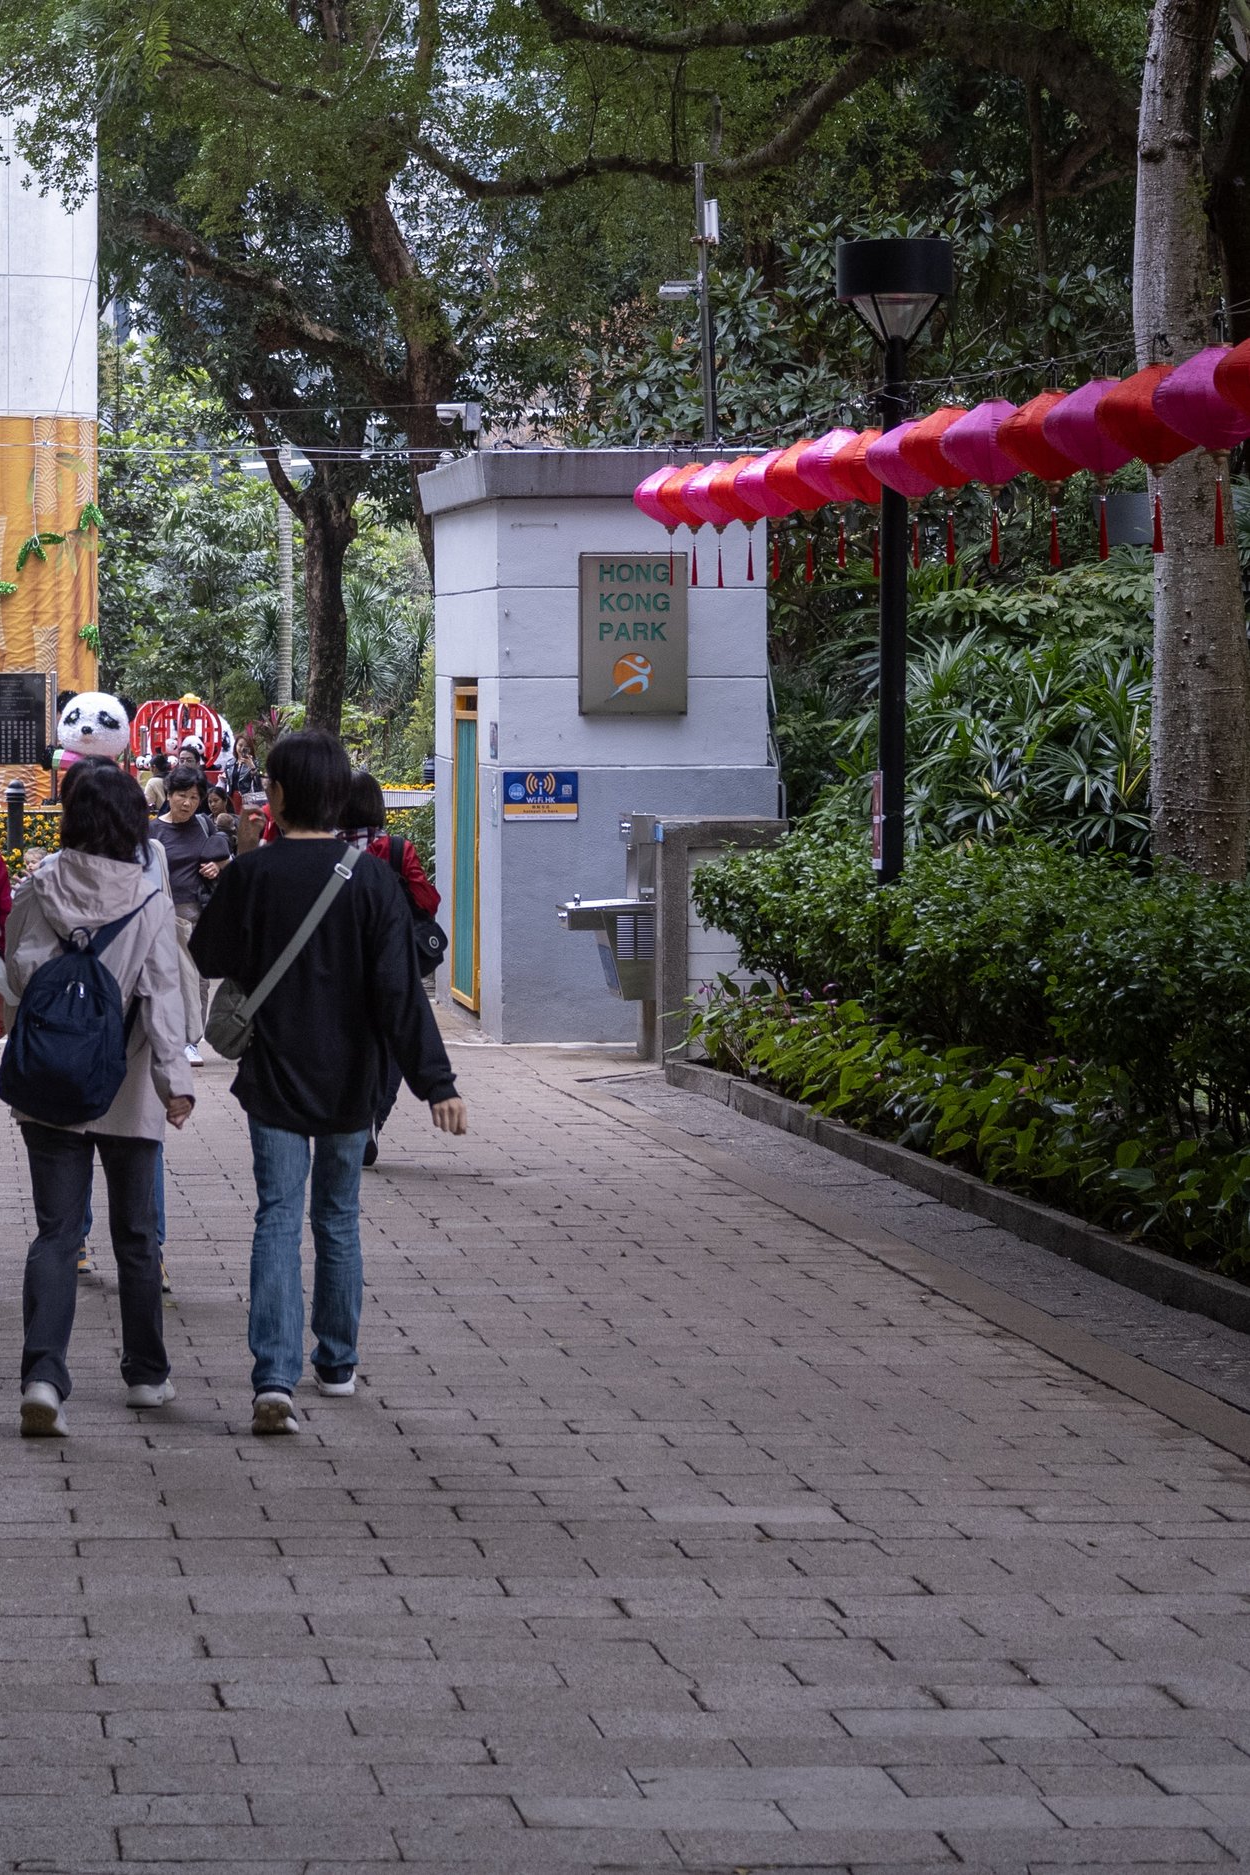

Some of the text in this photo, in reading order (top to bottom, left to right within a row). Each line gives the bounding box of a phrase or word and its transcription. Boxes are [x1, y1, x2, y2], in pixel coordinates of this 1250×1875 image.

[598, 563, 671, 584] HONG
[598, 592, 671, 613] KONG
[598, 622, 668, 642] PARK
